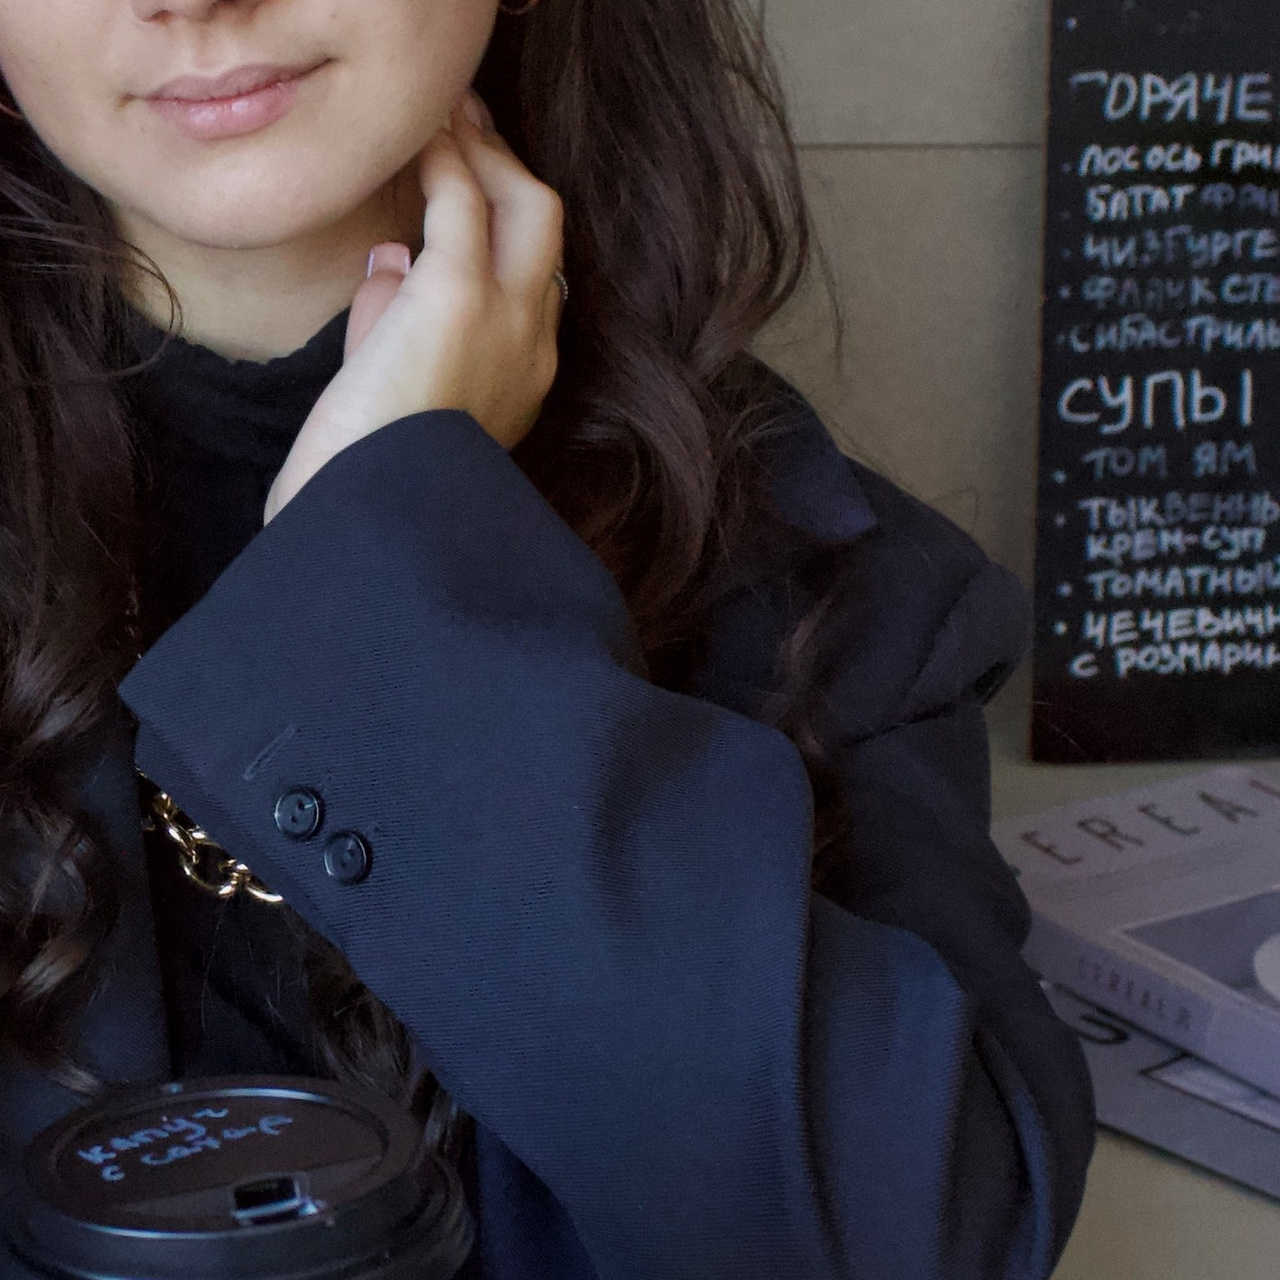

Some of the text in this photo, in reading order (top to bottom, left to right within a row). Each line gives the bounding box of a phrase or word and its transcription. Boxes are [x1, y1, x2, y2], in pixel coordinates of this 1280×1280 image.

[1057, 368, 1253, 435] СУПЫ
[1081, 440, 1257, 480] ТОМ ЯМ
[1013, 778, 1280, 876] EREA
